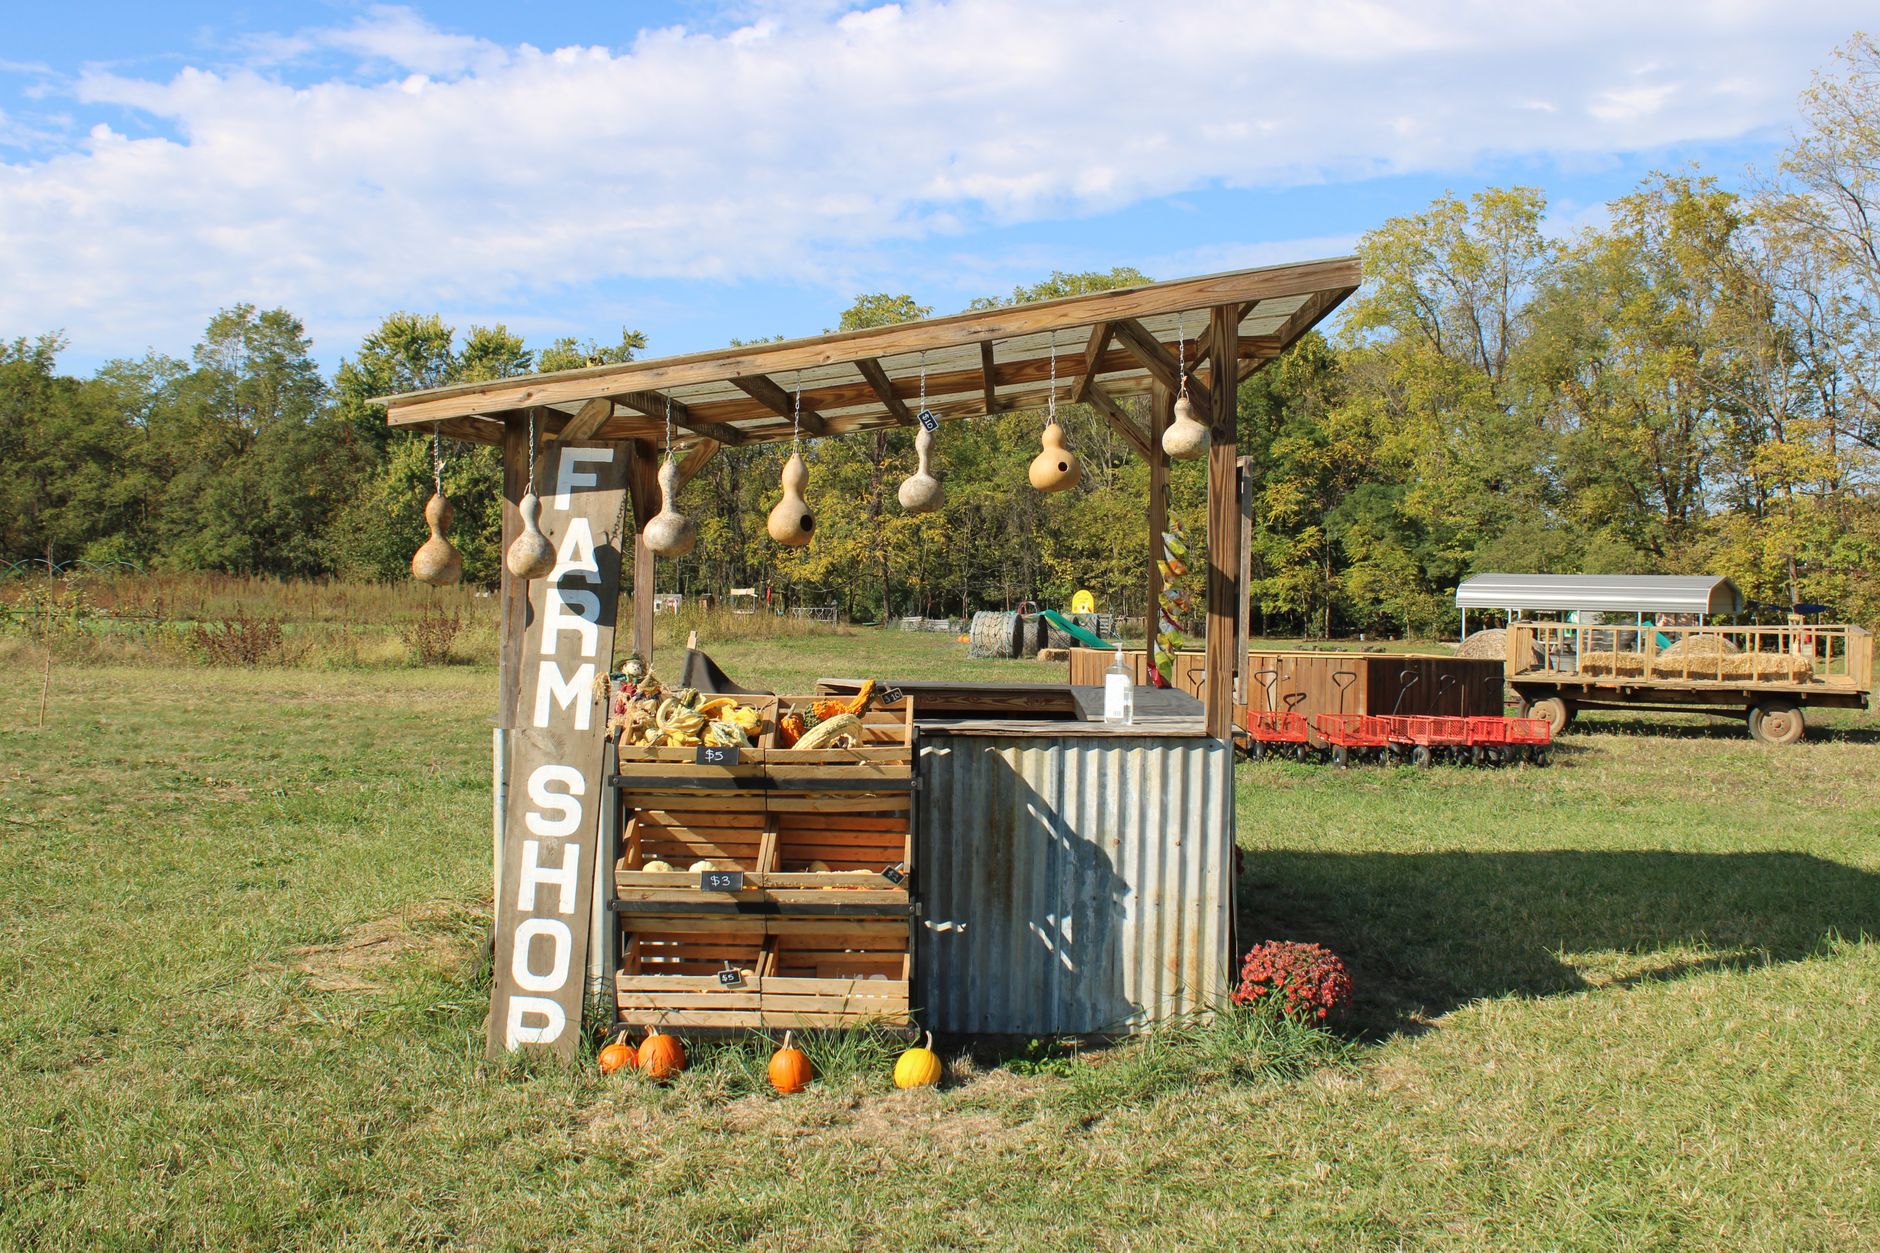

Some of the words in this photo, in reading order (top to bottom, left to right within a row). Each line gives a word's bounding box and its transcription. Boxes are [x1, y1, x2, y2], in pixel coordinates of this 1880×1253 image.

[921, 413, 934, 429] $10
[533, 447, 614, 730] FARM
[704, 748, 724, 763] $5
[710, 874, 731, 887] $3
[506, 765, 585, 1052] SHOP
[721, 973, 735, 982] $5
